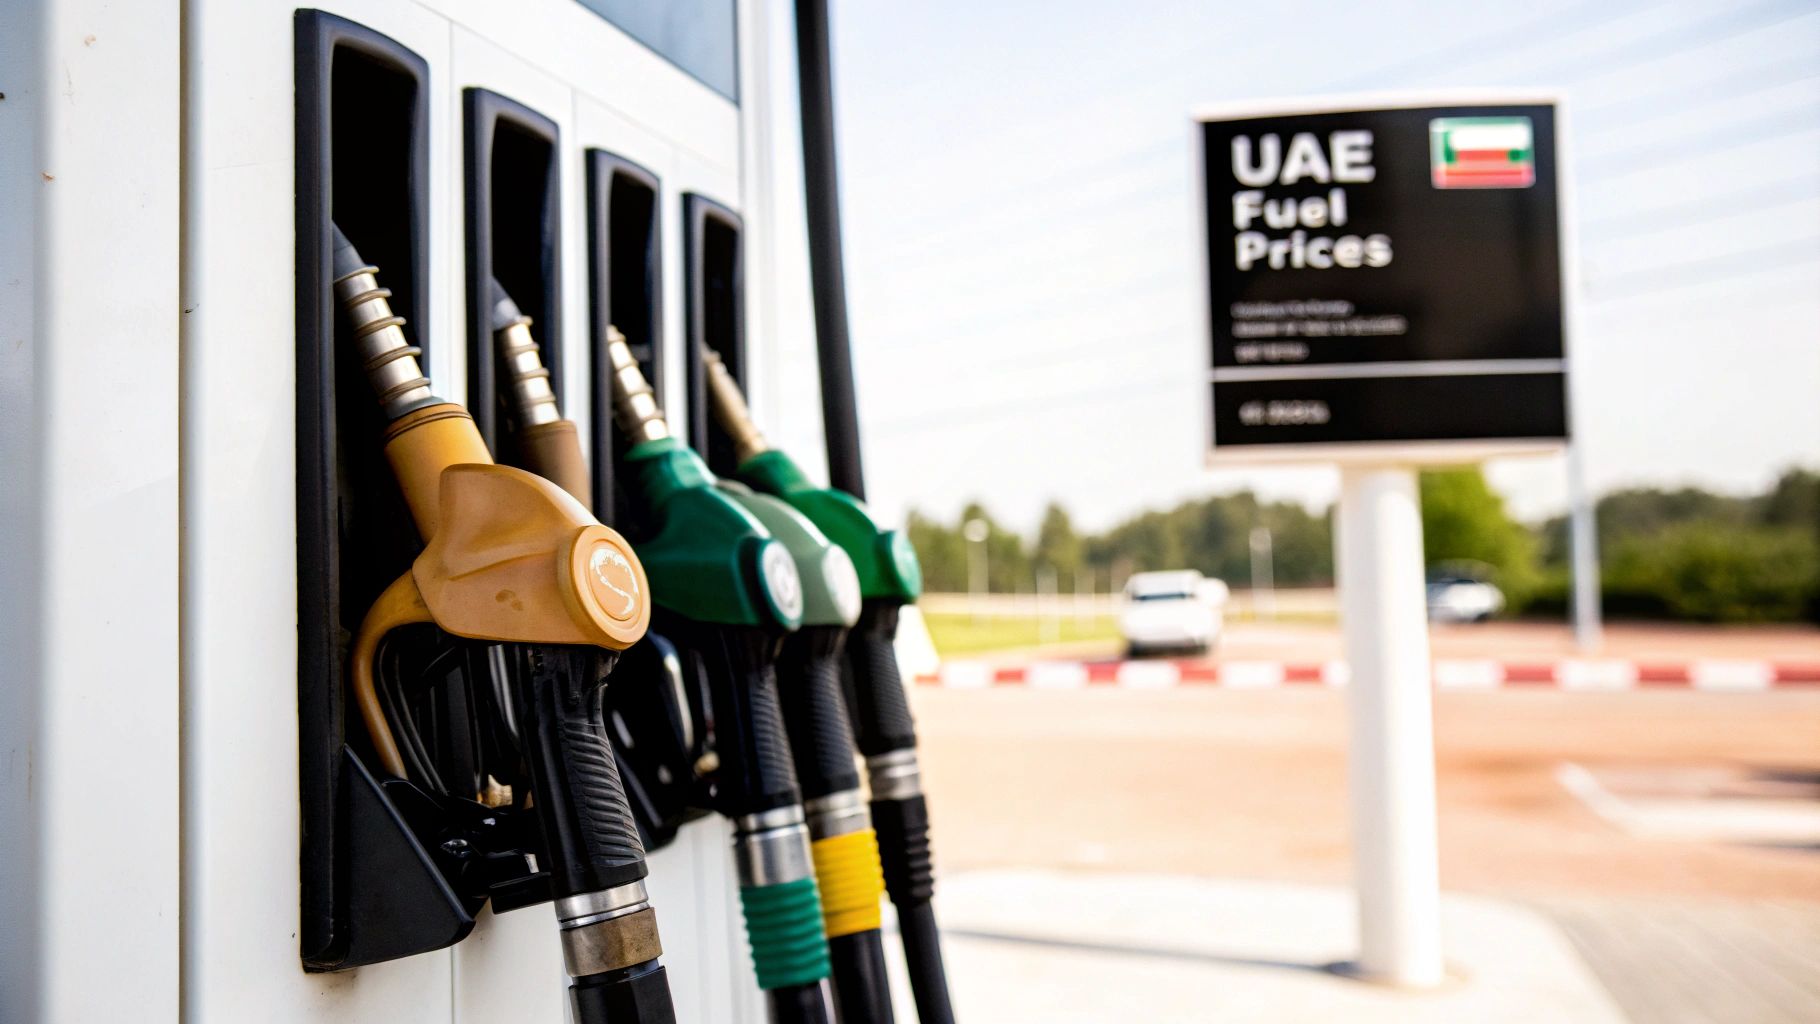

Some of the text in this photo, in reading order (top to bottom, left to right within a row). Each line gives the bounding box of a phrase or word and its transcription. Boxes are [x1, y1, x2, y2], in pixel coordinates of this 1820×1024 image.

[1231, 130, 1376, 187] UAE
[1232, 188, 1348, 230] Fuel
[1235, 231, 1394, 271] Prices
